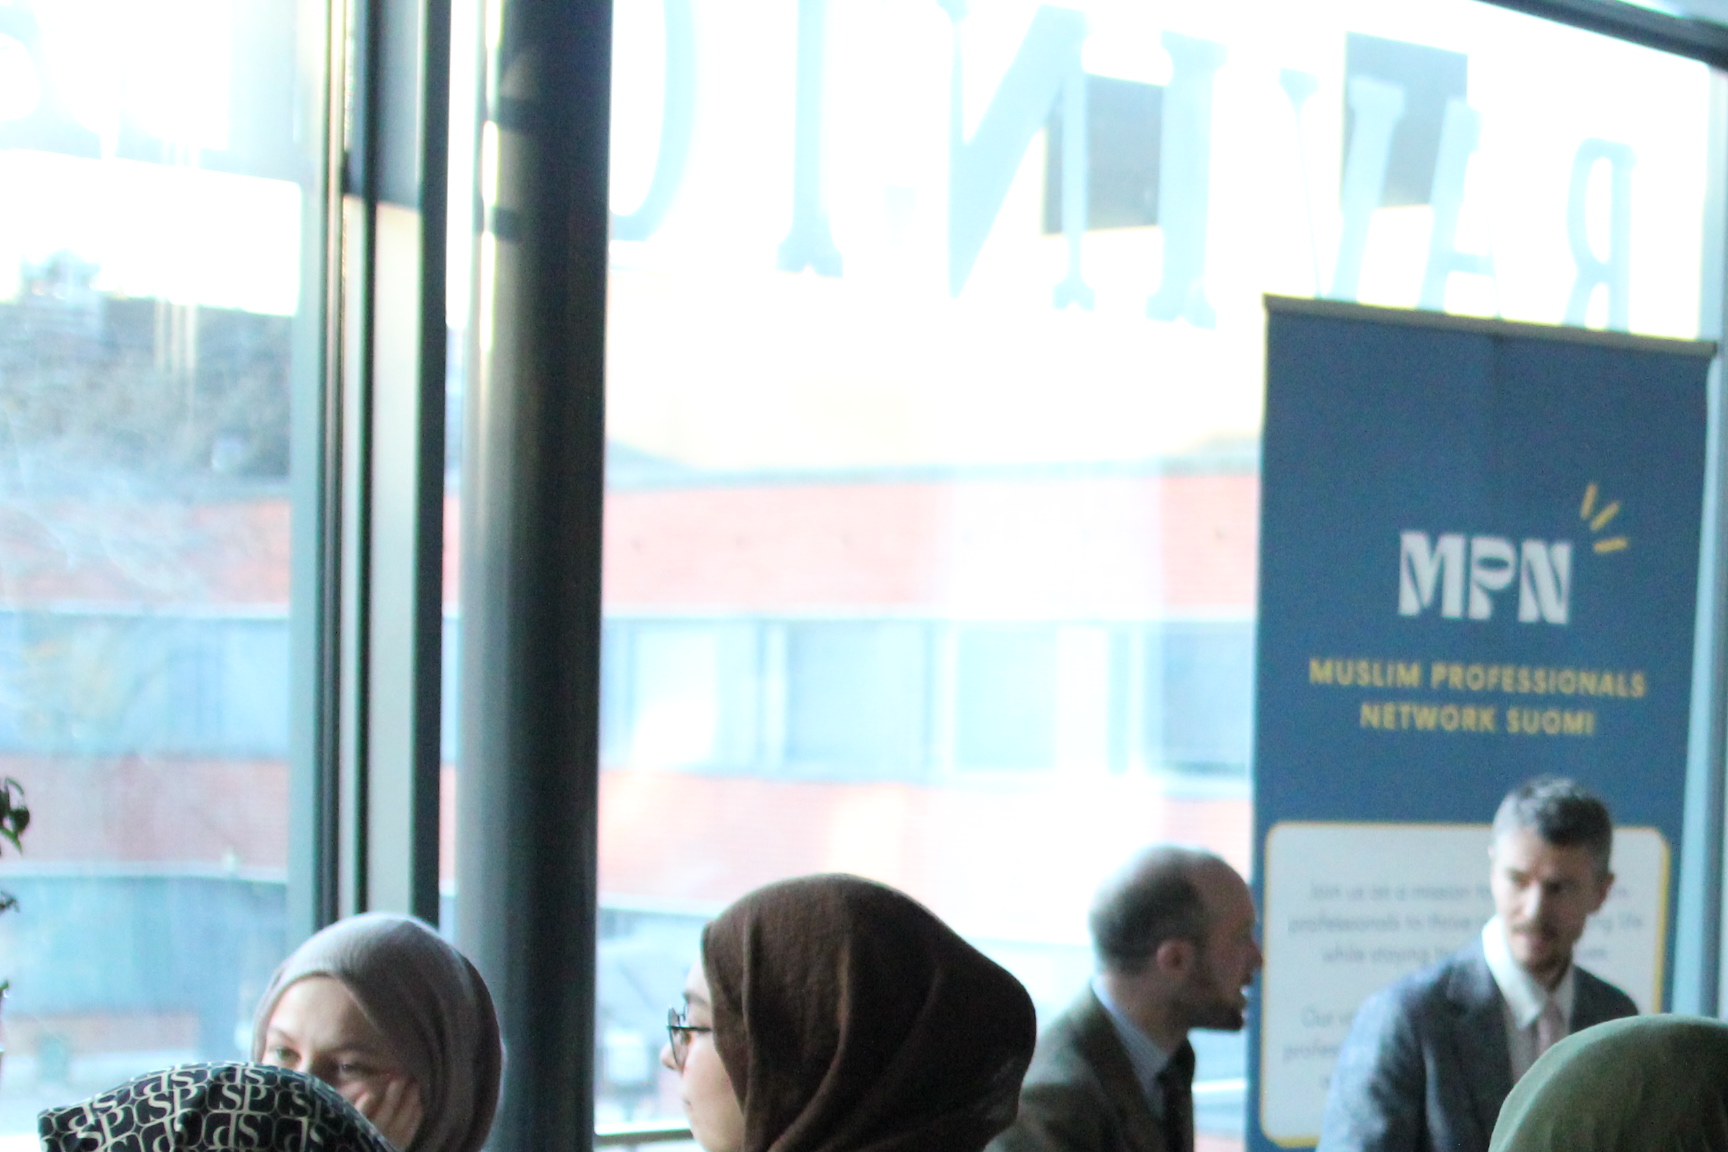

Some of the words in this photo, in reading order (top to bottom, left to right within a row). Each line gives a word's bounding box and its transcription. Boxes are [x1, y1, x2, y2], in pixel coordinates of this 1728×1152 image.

[1399, 530, 1573, 624] MPN
[1310, 659, 1421, 687] MUSLIM
[1431, 665, 1646, 697] PROFESSIONALS
[1360, 704, 1495, 732] NETWORK
[1507, 707, 1595, 736] SUOMI
[1288, 913, 1400, 934] professionals
